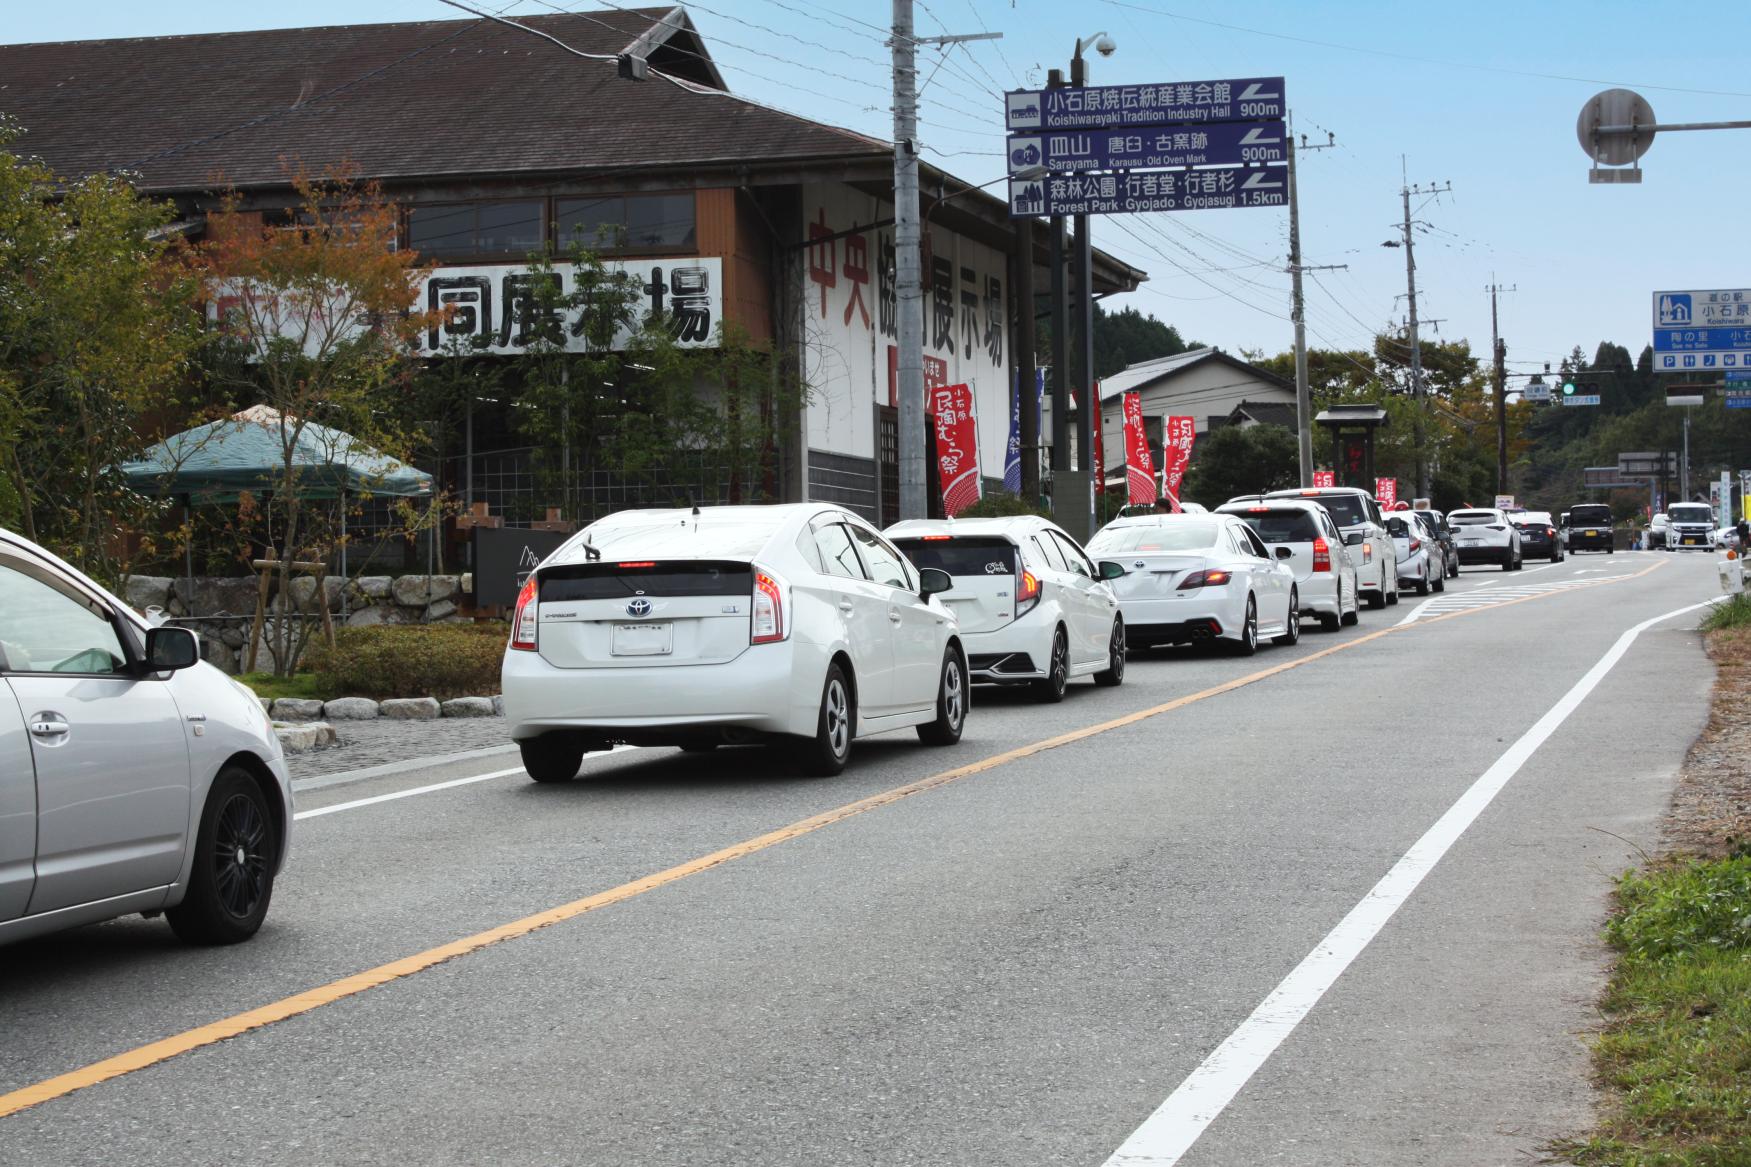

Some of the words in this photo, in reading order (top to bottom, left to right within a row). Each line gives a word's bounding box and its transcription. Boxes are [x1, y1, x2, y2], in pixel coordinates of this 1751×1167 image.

[1047, 83, 1231, 112] 小石原焼伝統産業会館
[1047, 111, 1121, 127] Koishiwarayaki
[1122, 110, 1165, 123] Tradition
[1167, 108, 1208, 122] Industry
[1211, 105, 1231, 118] Hall
[1240, 103, 1279, 117] 900m
[1049, 135, 1091, 157] 皿山
[1242, 147, 1281, 162] 900m
[1049, 158, 1099, 172] Sarayama
[1109, 157, 1143, 168] Karausu
[1147, 155, 1161, 166] Old
[1163, 155, 1185, 166] Oven
[1186, 153, 1207, 164] Mark
[1050, 200, 1090, 214] Forest
[1092, 198, 1119, 212] Park
[1125, 197, 1176, 213] Gyojado
[1184, 193, 1236, 209] Gyojasugi
[1240, 191, 1283, 206] 1.5km
[1702, 303, 1749, 317] 小石原
[954, 389, 968, 421] 小石原
